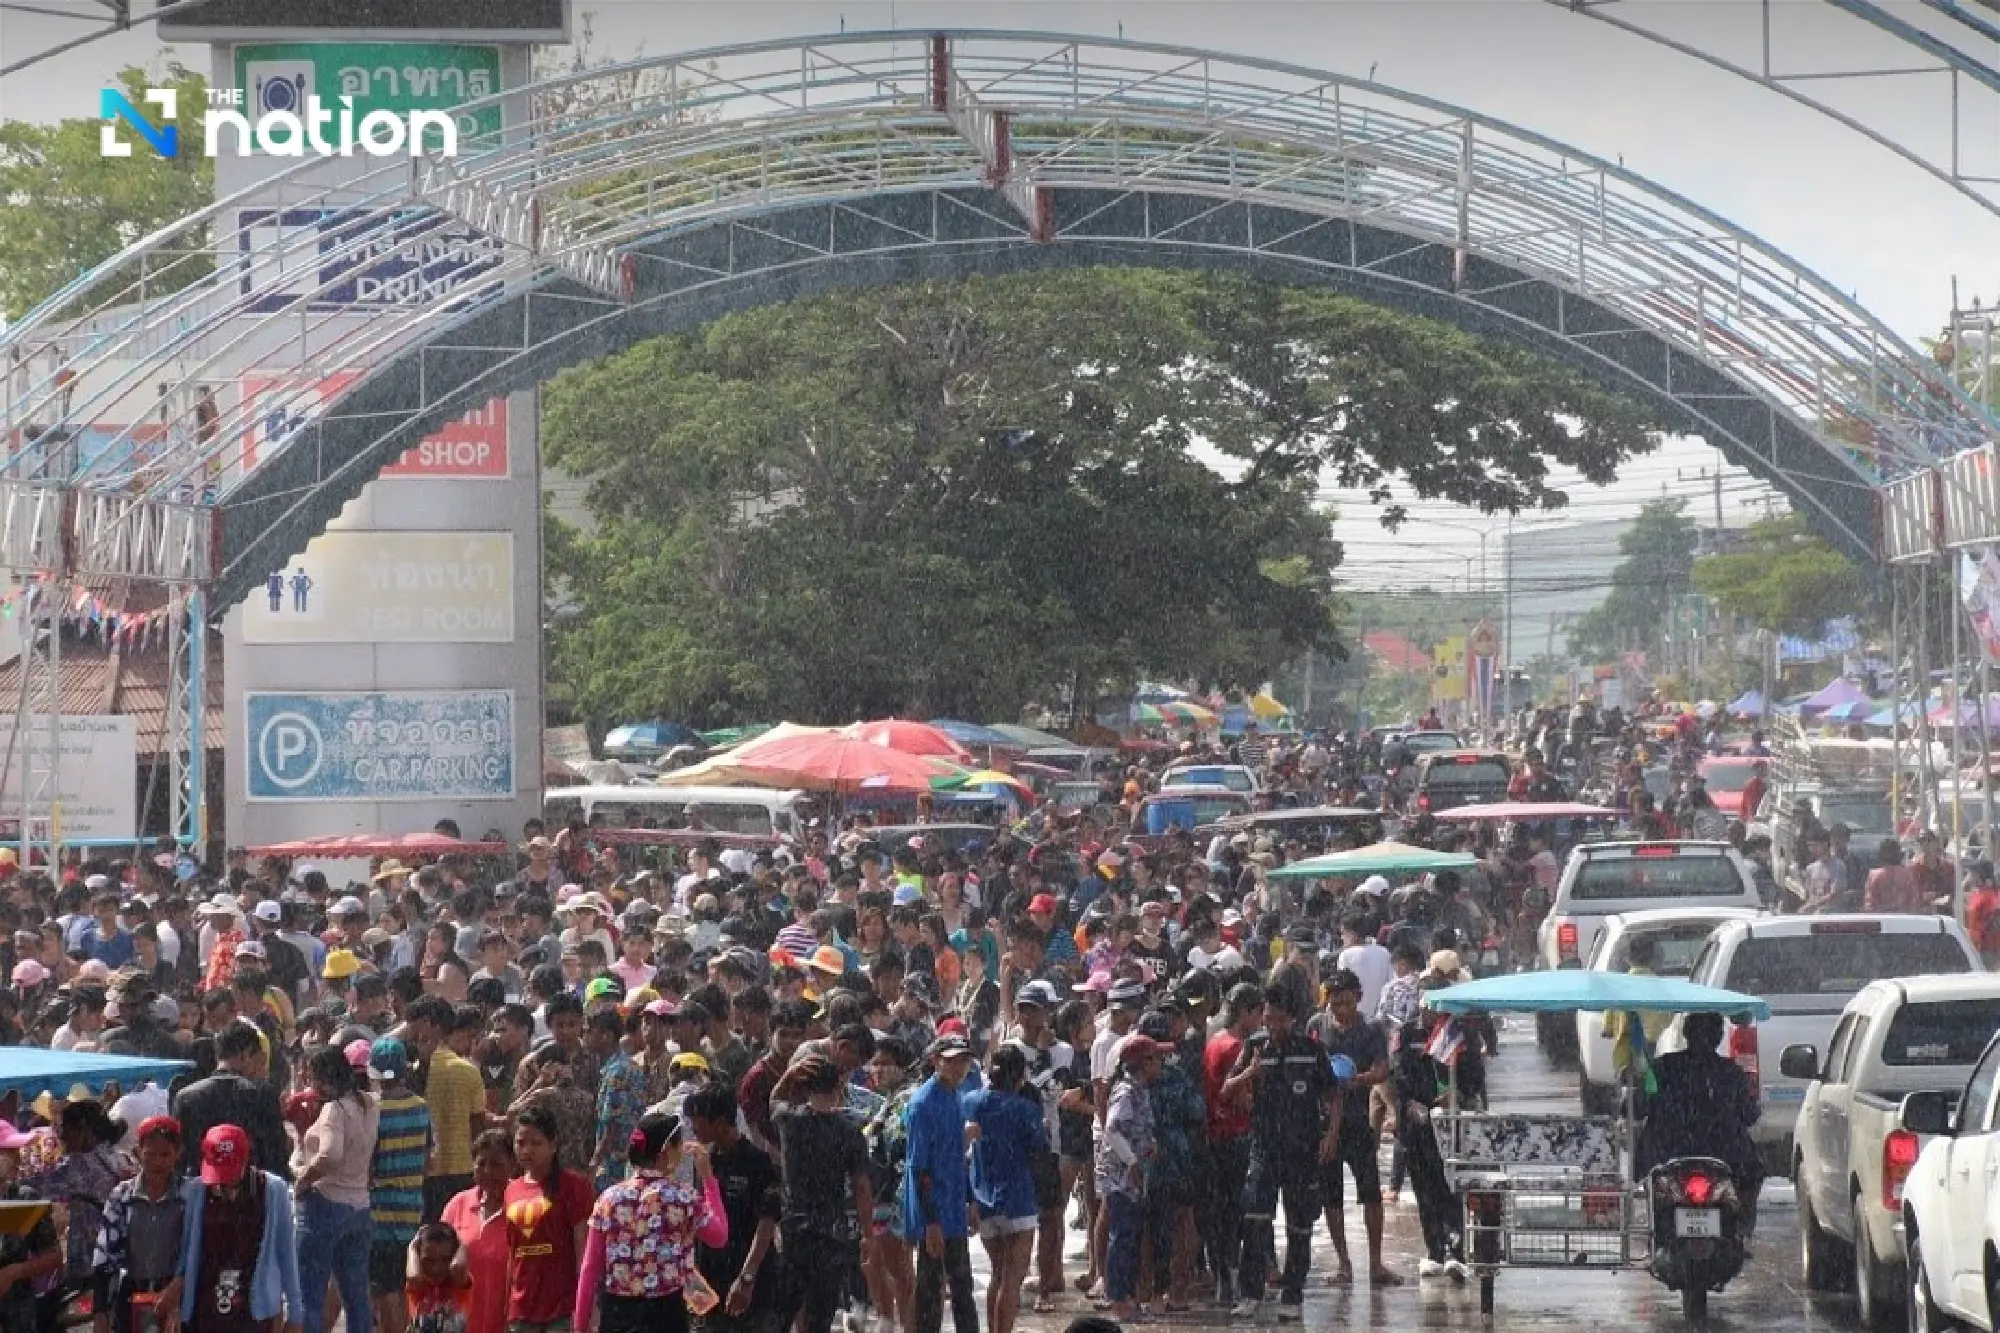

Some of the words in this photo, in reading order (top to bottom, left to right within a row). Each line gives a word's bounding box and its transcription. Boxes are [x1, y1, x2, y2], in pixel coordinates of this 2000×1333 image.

[338, 66, 490, 102] อาหาร
[419, 441, 490, 466] SHOP
[421, 606, 505, 631] ROOM
[277, 727, 307, 771] P
[355, 758, 402, 782] CAR
[410, 757, 499, 781] PARKING
